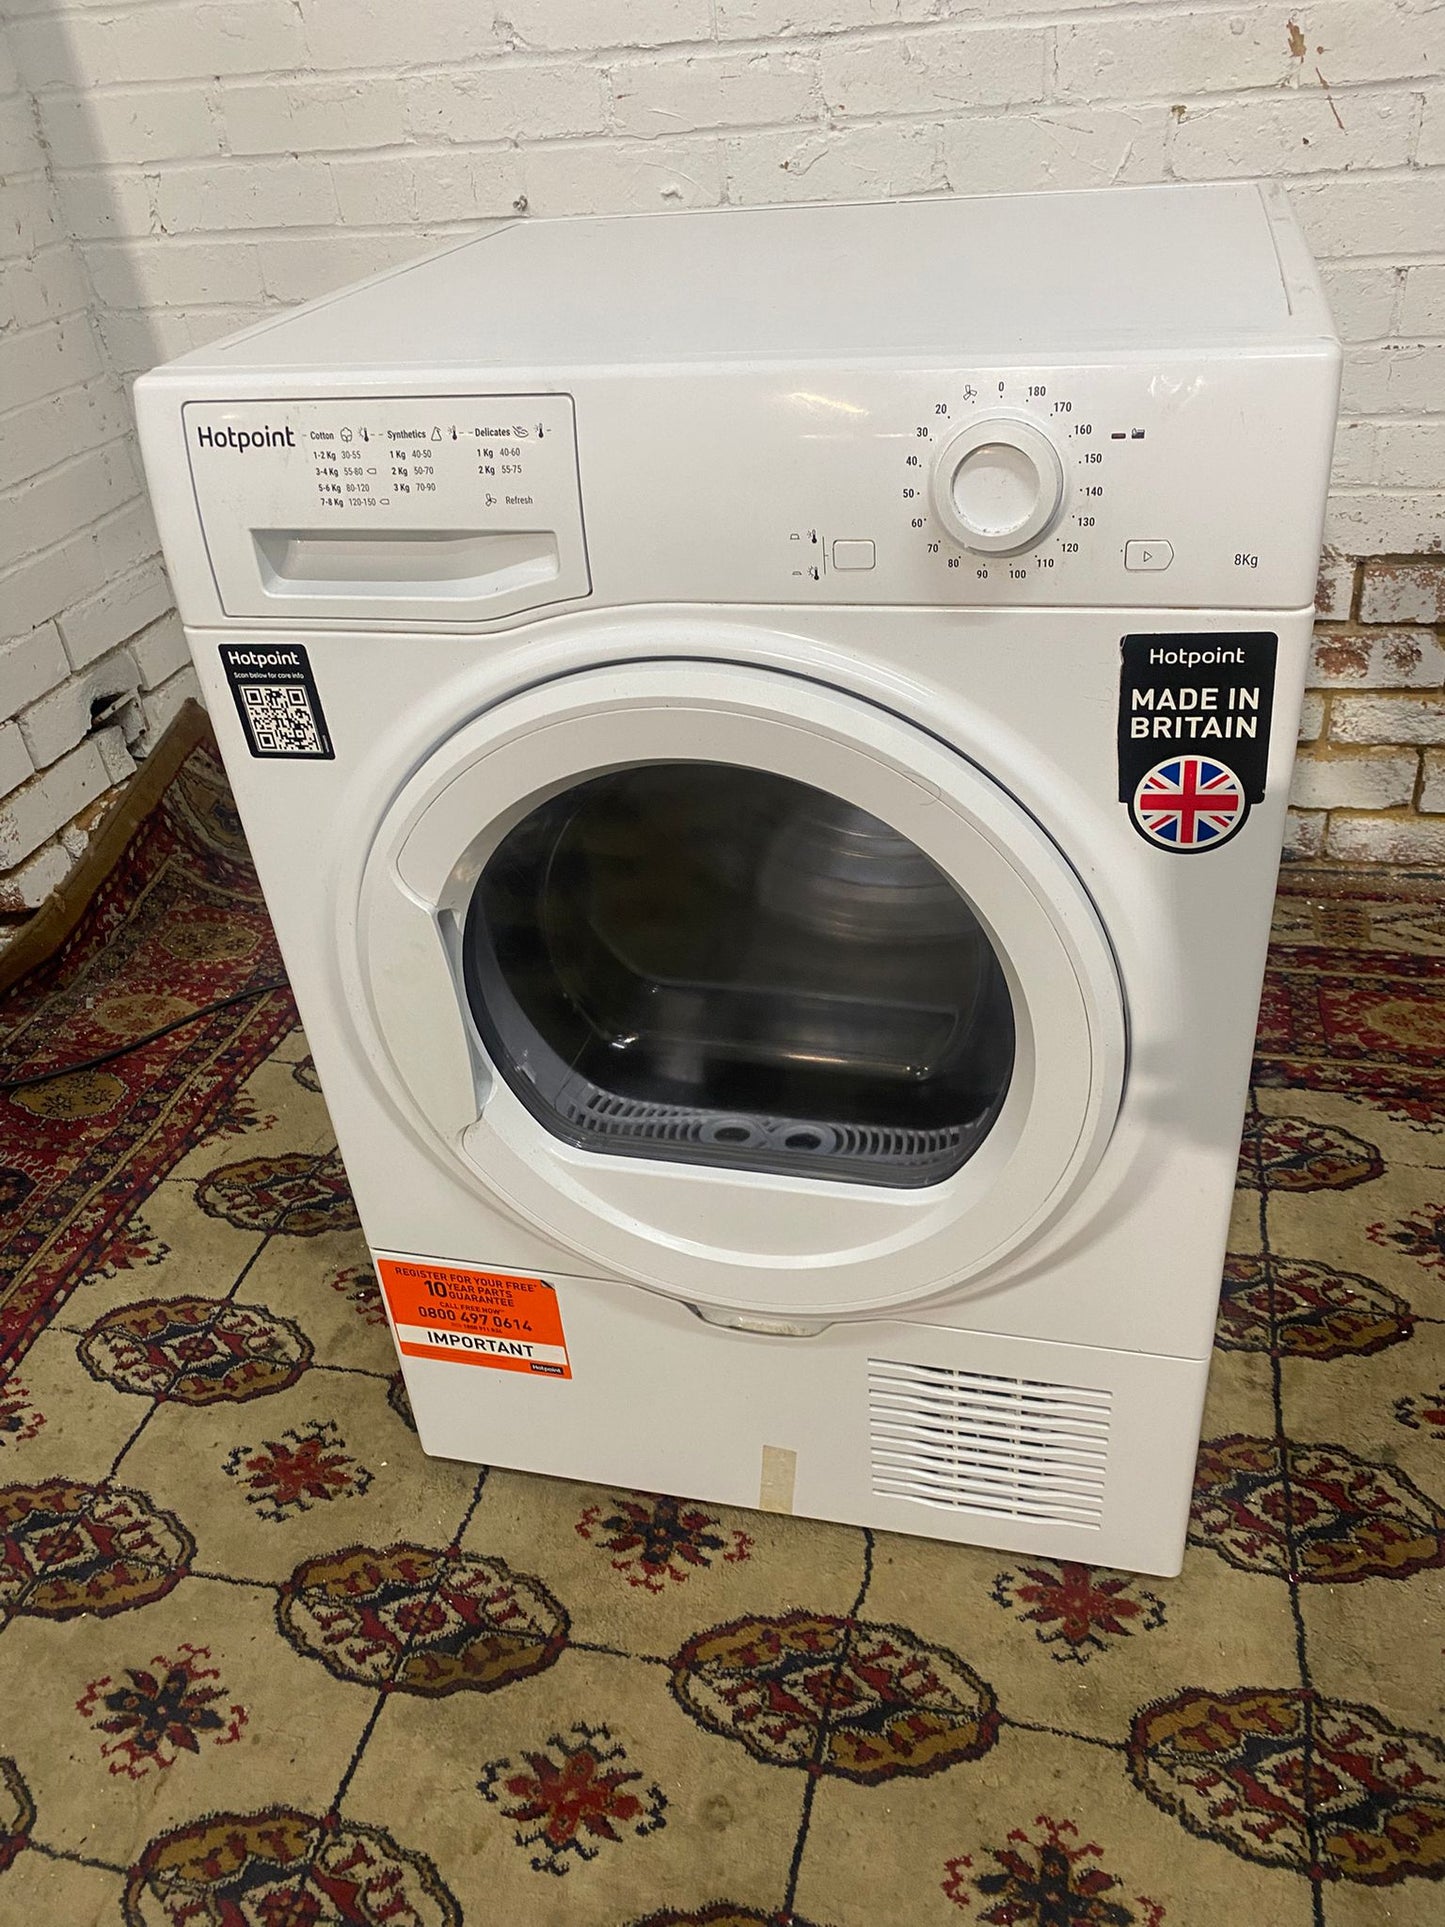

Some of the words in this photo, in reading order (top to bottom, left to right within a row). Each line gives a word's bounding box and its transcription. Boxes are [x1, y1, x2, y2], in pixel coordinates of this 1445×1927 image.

[998, 381, 1005, 392] 0
[1028, 386, 1047, 397] 180
[935, 403, 947, 415] 20
[1054, 401, 1072, 413] 170
[475, 427, 511, 437] Delicates
[916, 427, 929, 438] 30
[1075, 424, 1092, 435] 160
[197, 424, 297, 454] Hotpoint
[310, 431, 335, 440] Cotton
[387, 429, 427, 442] Synthetics
[326, 451, 336, 462] Kg
[341, 450, 361, 460] 30-55
[395, 450, 406, 461] Kg
[412, 449, 432, 459] 40-50
[483, 448, 494, 459] Kg
[500, 447, 521, 457] 40-60
[1084, 453, 1103, 464] 150
[906, 455, 918, 466] 40
[329, 467, 339, 478] Kg
[344, 467, 363, 476] 55-80
[398, 467, 408, 477] Kg
[414, 466, 434, 475] 50-70
[485, 465, 495, 475] Kg
[501, 464, 522, 474] 55-75
[331, 484, 342, 494] Kg
[346, 484, 370, 492] 80-120
[400, 483, 410, 494] Kg
[416, 483, 436, 492] 70-90
[903, 488, 914, 499] 50
[1085, 486, 1103, 497] 140
[333, 498, 344, 508] Kg
[349, 498, 377, 507] 120-150
[505, 495, 534, 505] Refresh
[911, 518, 923, 528] 60
[1078, 517, 1095, 527] 130
[927, 543, 939, 553] 70
[1061, 542, 1079, 553] 120
[947, 558, 959, 568] 80
[1037, 558, 1054, 568] 110
[1234, 554, 1258, 568] 8Kg
[976, 569, 988, 579] 90
[1009, 569, 1027, 579] 100
[227, 650, 300, 668] Hotpoint
[1150, 647, 1246, 668] Hotpoint
[233, 671, 249, 679] Scan
[248, 671, 268, 679] below
[267, 671, 277, 679] for
[277, 671, 292, 679] care
[291, 671, 305, 679] info
[1131, 687, 1219, 711] MADE
[1228, 687, 1260, 710] IN
[1130, 716, 1258, 739] BRITAIN
[394, 1266, 447, 1281] REGISTER
[449, 1273, 473, 1285] FOR
[473, 1277, 503, 1289] YOUR
[424, 1280, 447, 1298] 10
[446, 1282, 475, 1293] YEAR
[477, 1286, 513, 1298] PARTS
[448, 1291, 515, 1307] GUARANTEE
[439, 1302, 459, 1310] CALL
[460, 1304, 480, 1313] FREE
[418, 1306, 456, 1321] 0800
[460, 1311, 488, 1325] 497
[492, 1315, 533, 1332] 0614
[427, 1331, 534, 1357] IMPORTANT
[531, 1363, 563, 1374] Hotpoint
